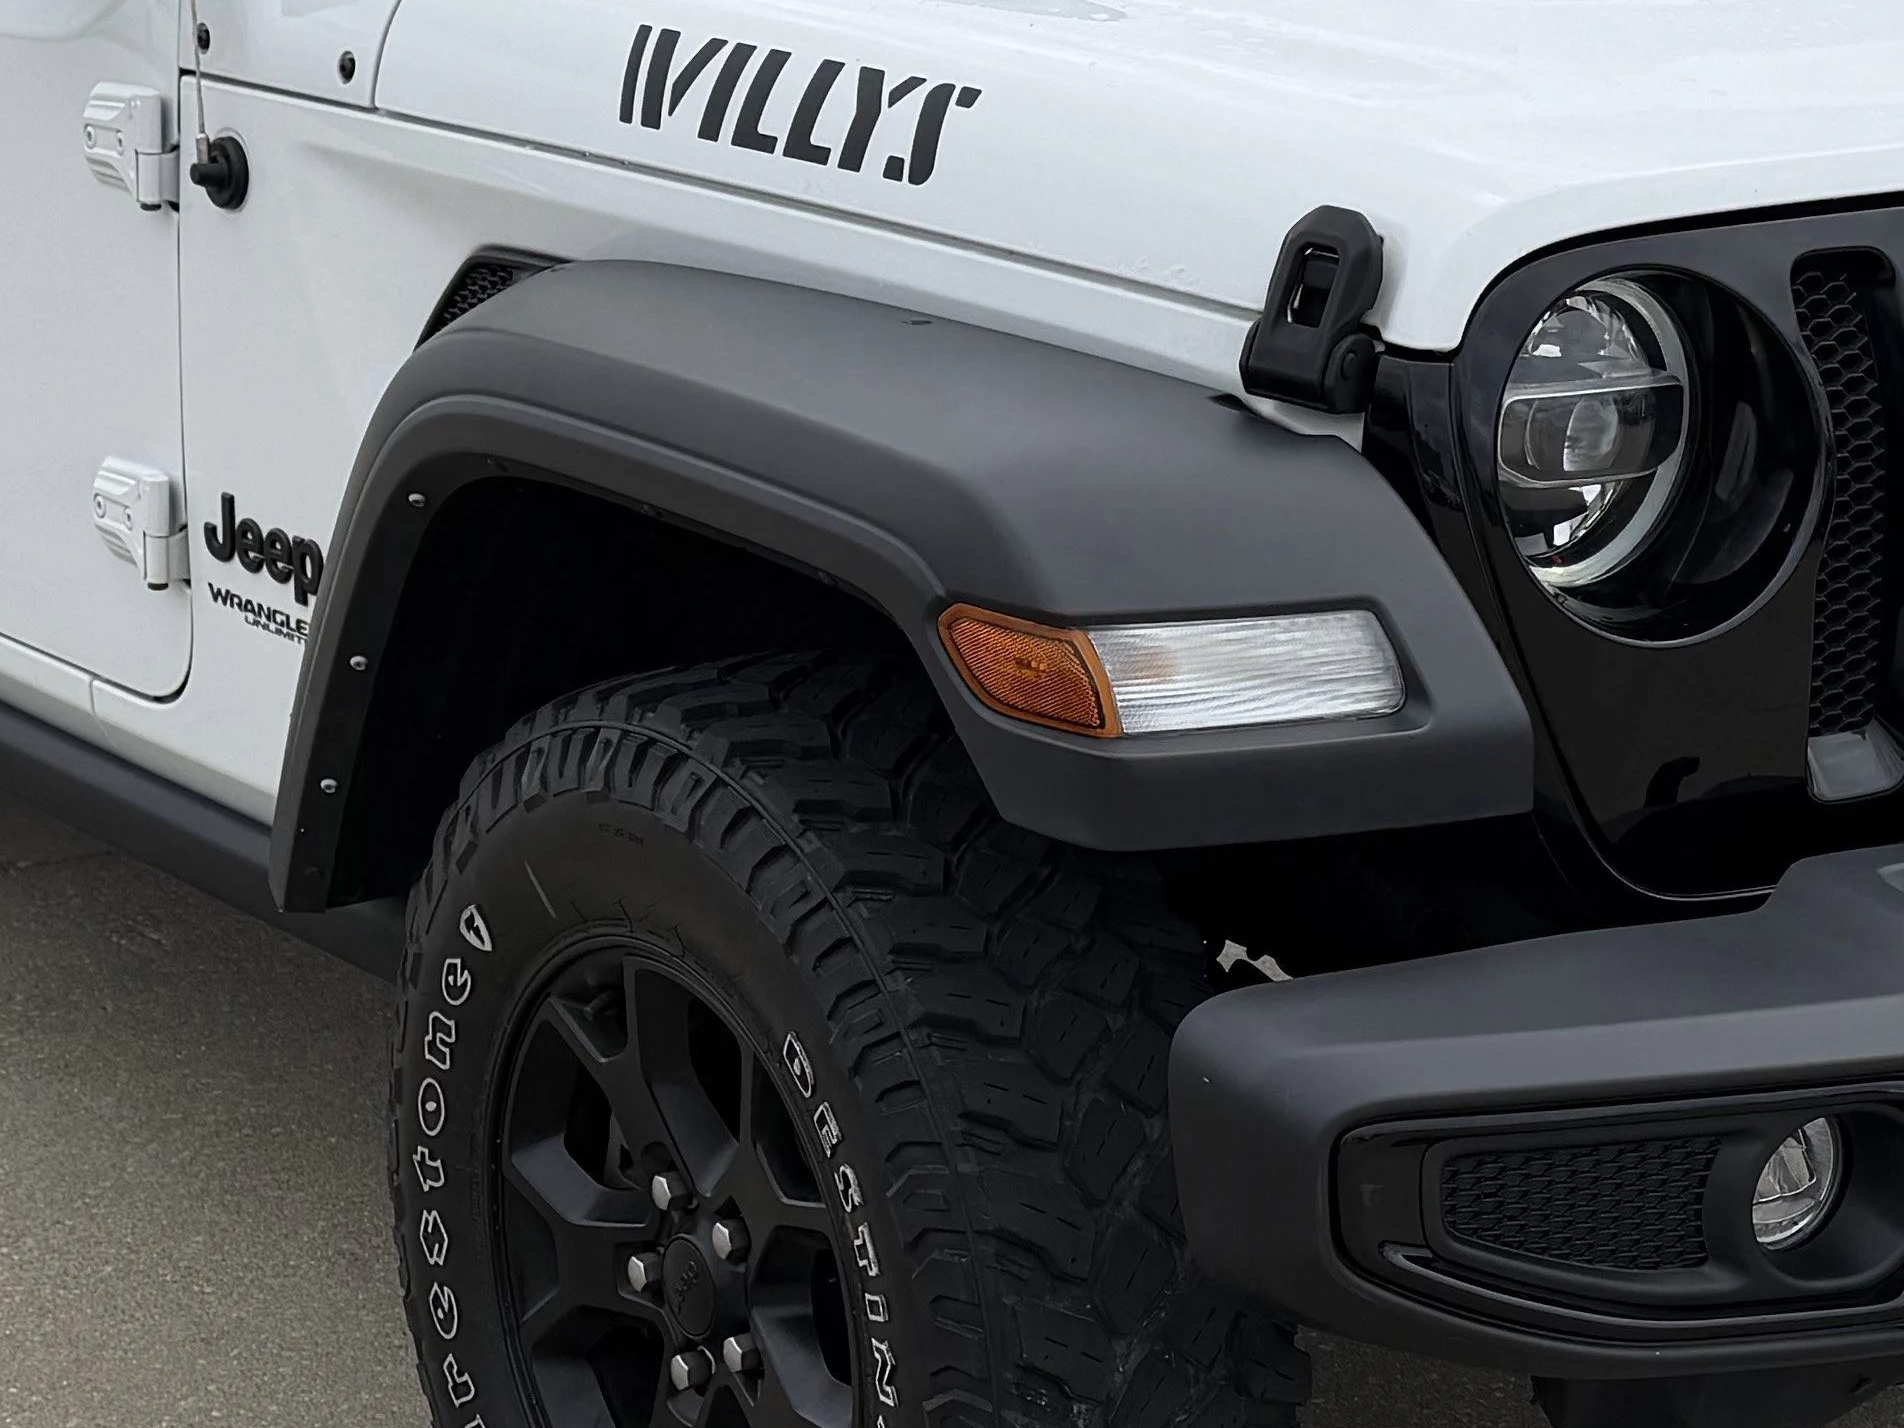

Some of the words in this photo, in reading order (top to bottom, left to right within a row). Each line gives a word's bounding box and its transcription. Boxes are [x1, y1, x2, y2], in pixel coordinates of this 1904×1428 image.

[619, 24, 982, 186] WILLYS
[203, 491, 325, 607] Jeep
[207, 581, 310, 637] WRANGLE
[245, 614, 308, 645] UNLIMIT
